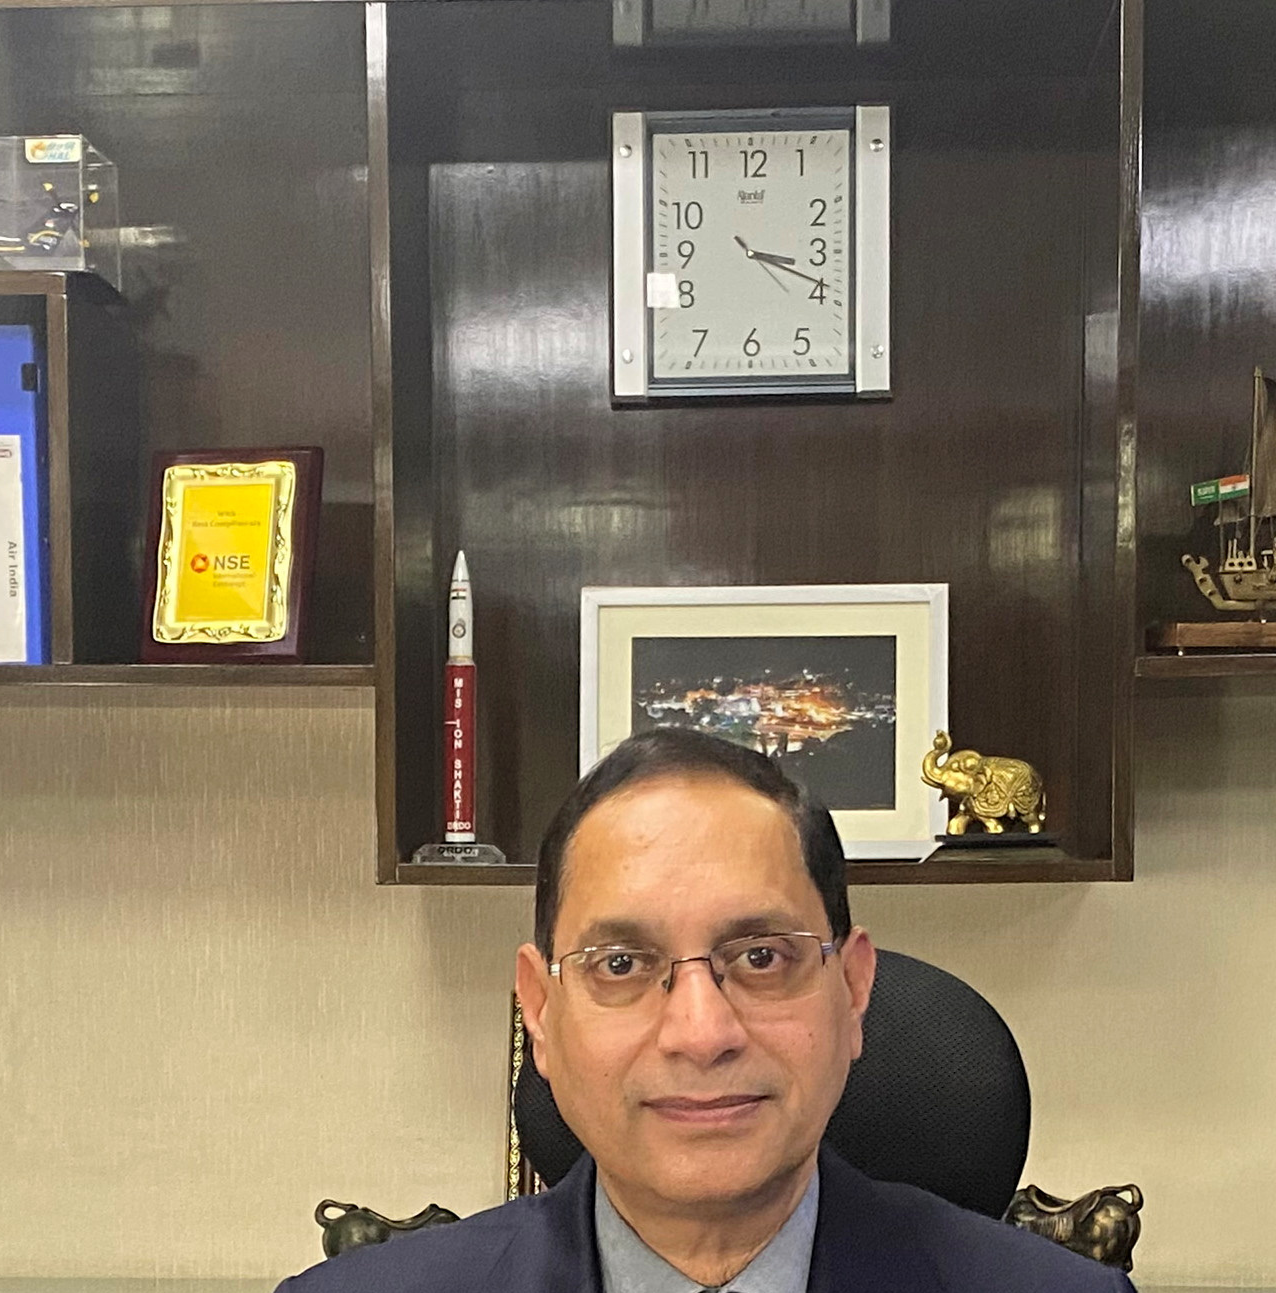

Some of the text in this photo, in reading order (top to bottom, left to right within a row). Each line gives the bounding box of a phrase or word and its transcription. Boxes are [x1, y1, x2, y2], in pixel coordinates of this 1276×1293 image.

[688, 151, 708, 178] 11
[739, 150, 767, 178] 12
[795, 148, 804, 176] 1
[672, 201, 703, 230] 10
[809, 198, 827, 226] 2
[677, 240, 695, 269] 9
[809, 238, 827, 266] 3
[678, 280, 695, 308] 8
[808, 277, 827, 305] 4
[692, 329, 709, 357] 7
[743, 327, 761, 357] 6
[793, 327, 811, 356] 5
[8, 541, 19, 597] Air India
[214, 555, 250, 571] NSE
[453, 759, 463, 820] SHAKTI
